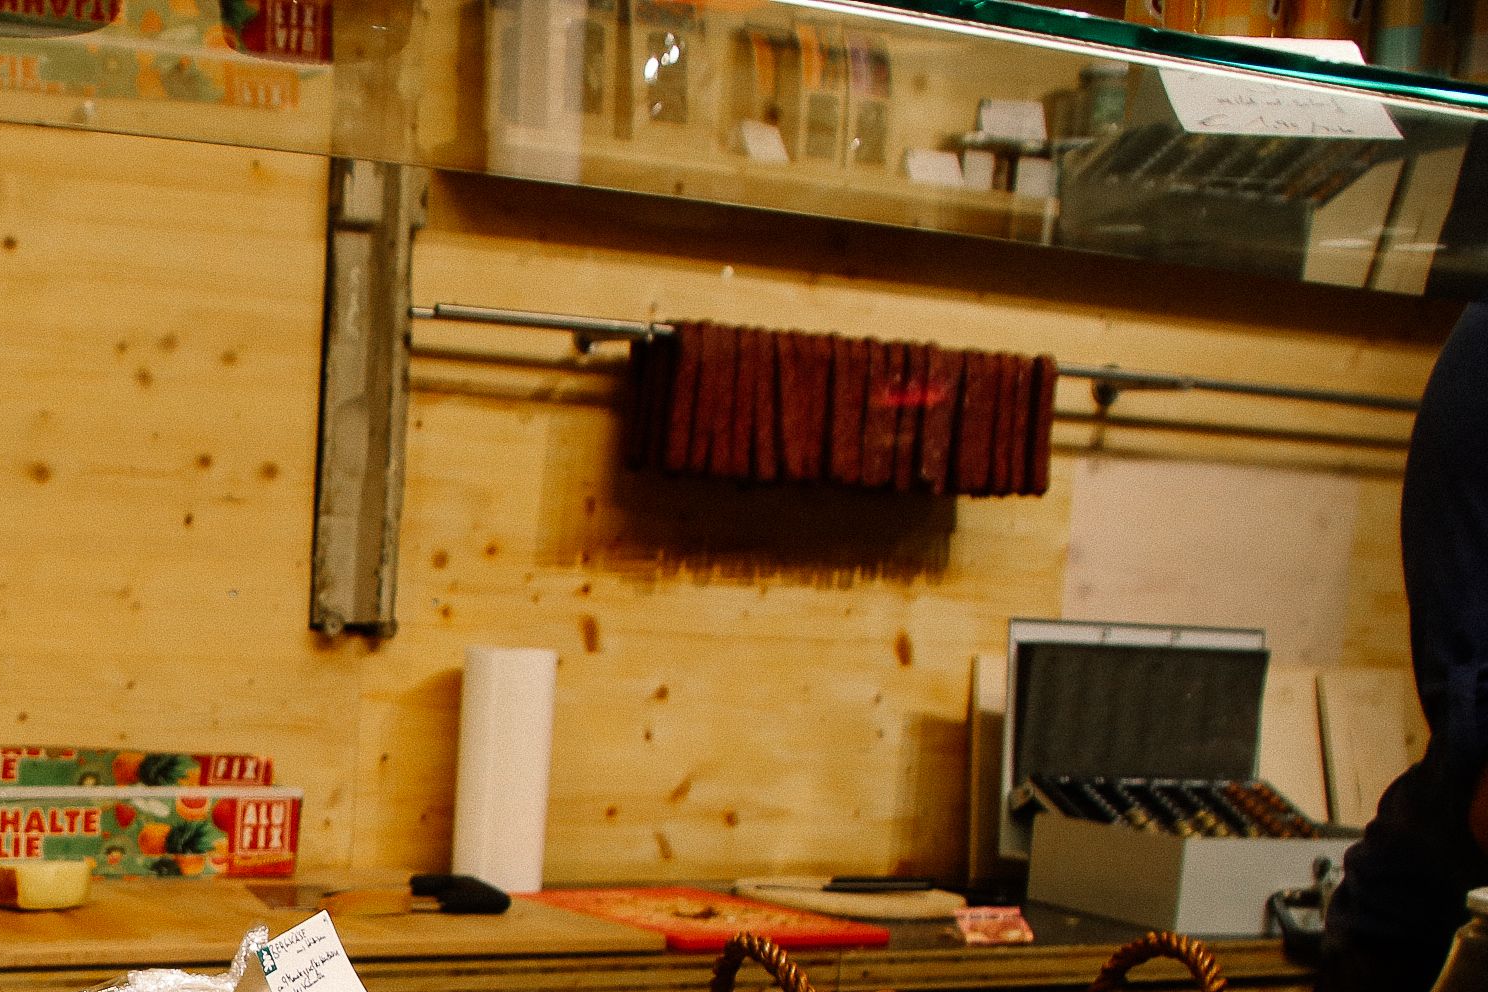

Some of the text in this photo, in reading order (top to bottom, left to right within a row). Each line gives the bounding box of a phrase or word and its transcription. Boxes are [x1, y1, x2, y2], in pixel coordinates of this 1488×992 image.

[215, 757, 256, 780] FIX
[243, 801, 285, 825] ALU
[242, 826, 284, 849] FIX
